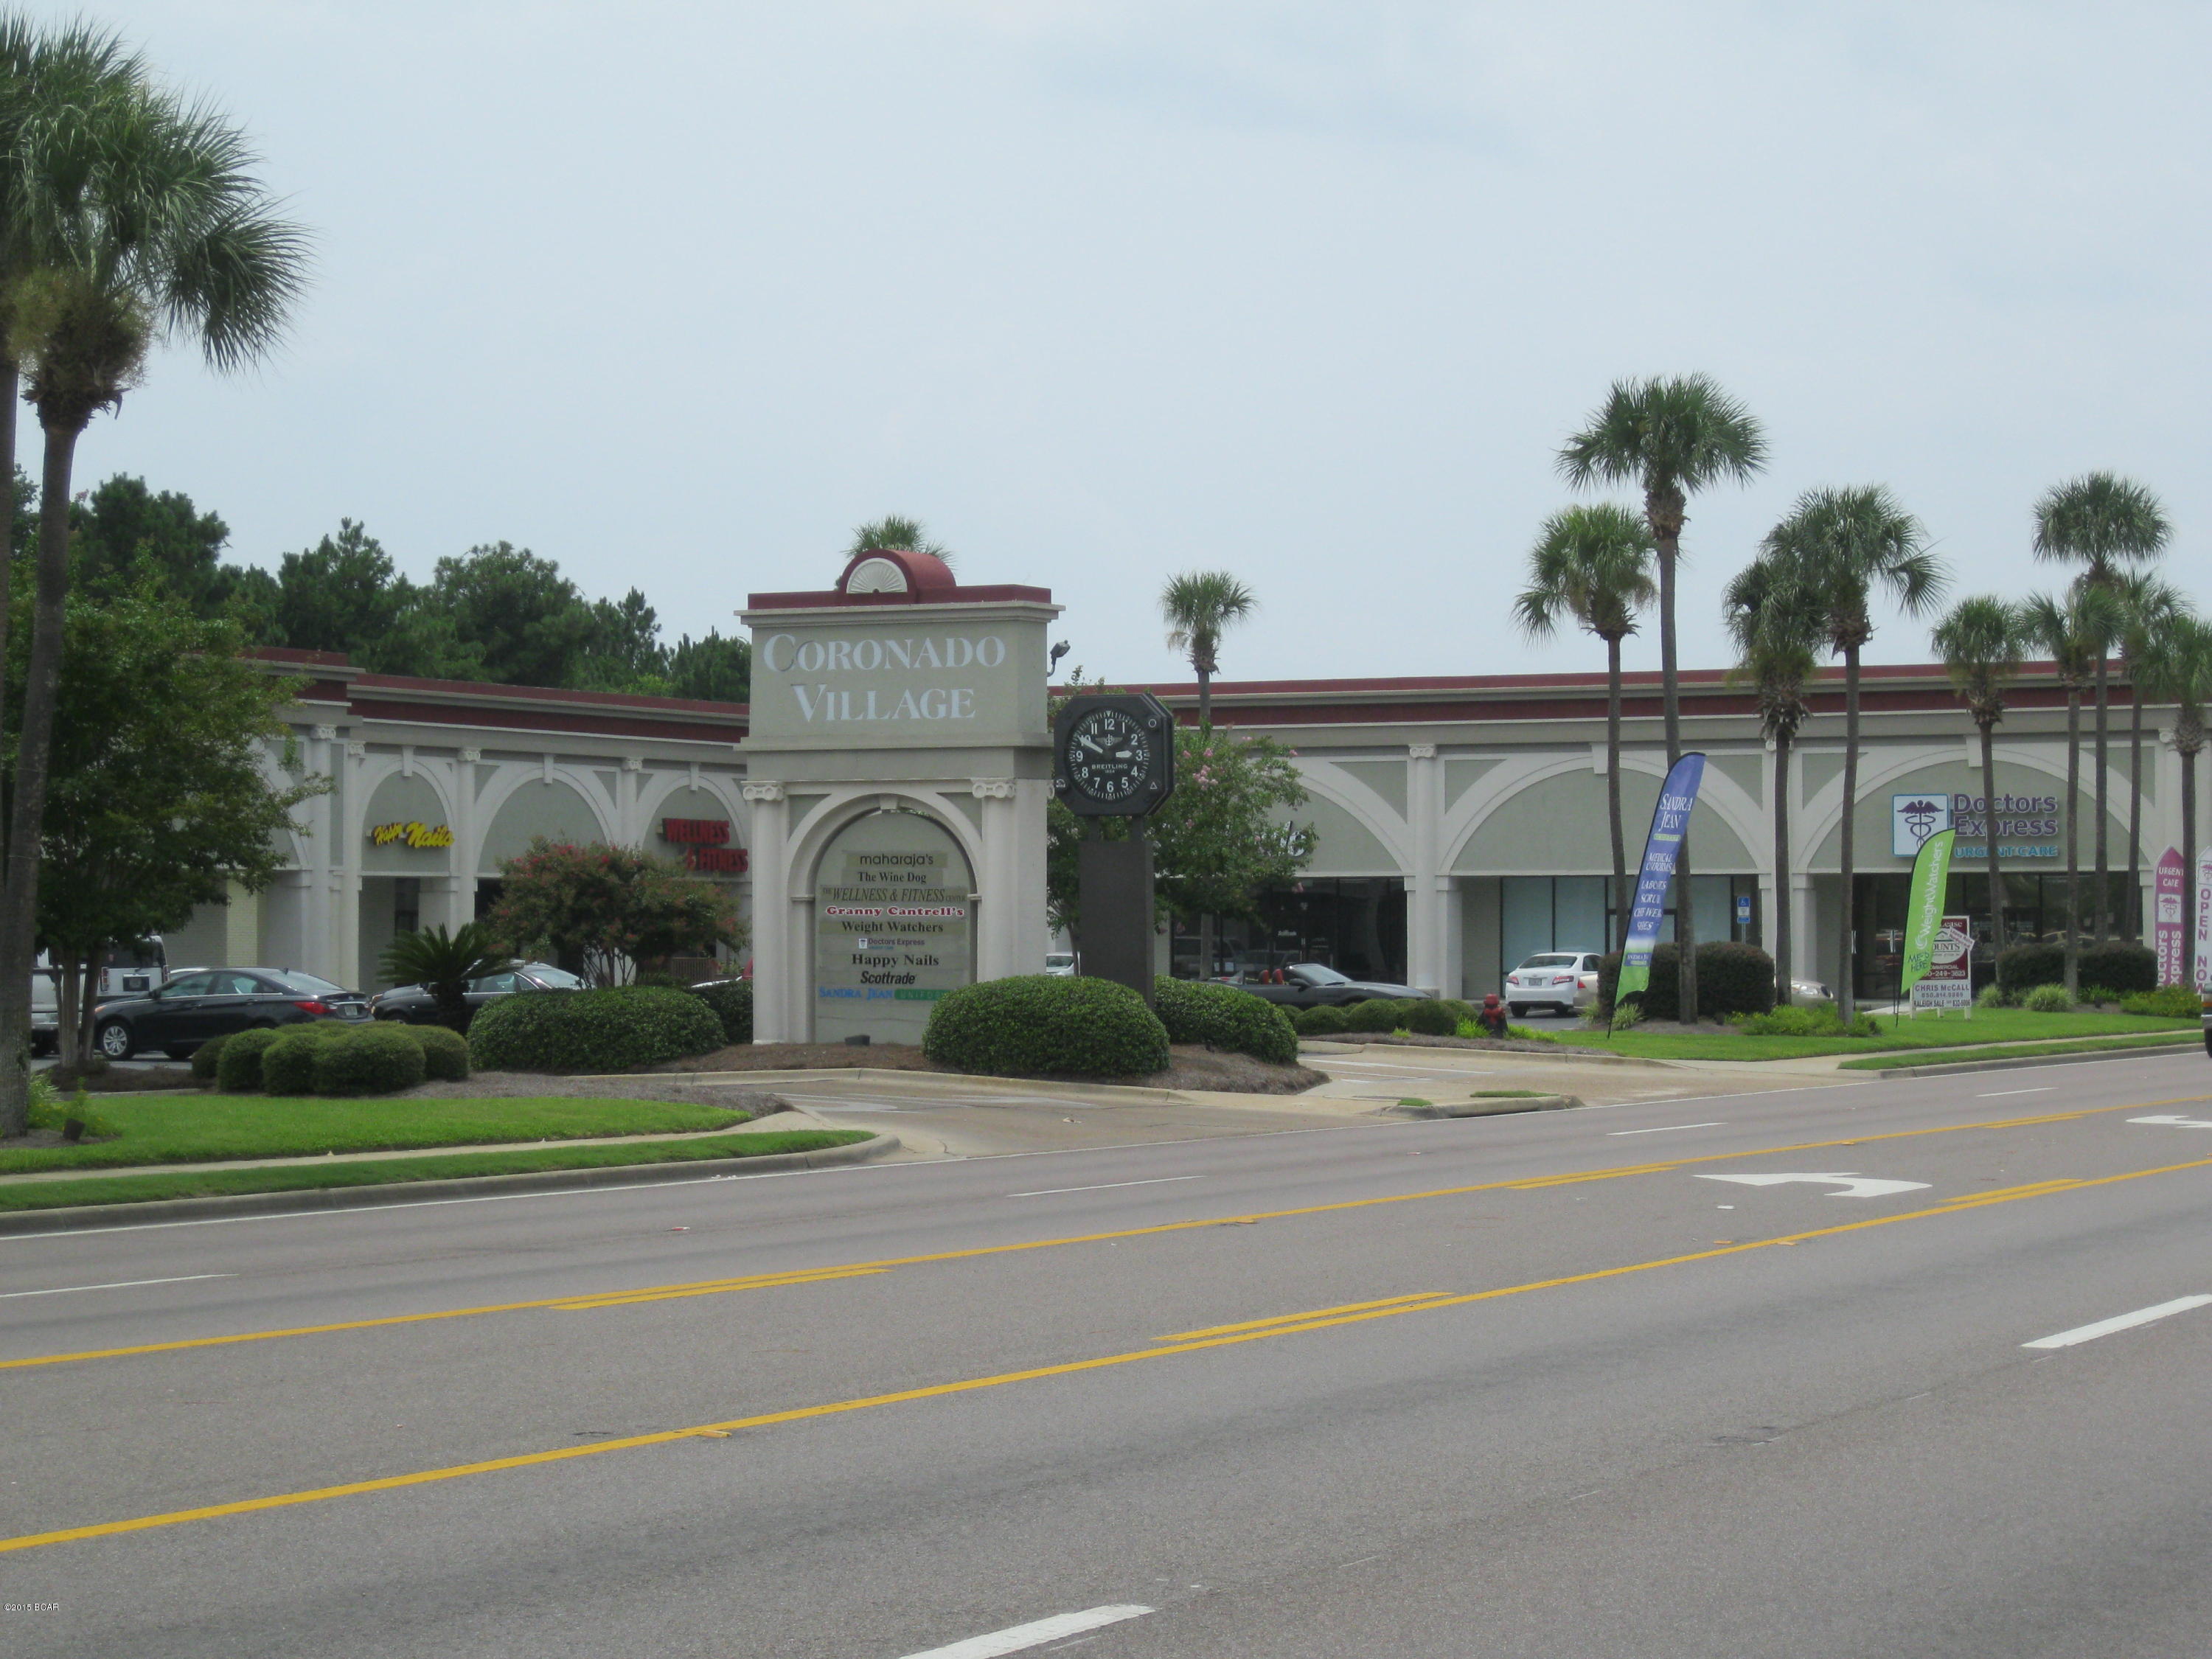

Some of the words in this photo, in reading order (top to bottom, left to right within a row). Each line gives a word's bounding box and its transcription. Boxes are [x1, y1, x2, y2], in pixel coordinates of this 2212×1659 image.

[763, 633, 1006, 672] CORONADO
[790, 684, 976, 722] VILLAGE
[1105, 718, 1115, 730] 12
[1131, 734, 1138, 745] 2
[1076, 751, 1084, 762] 9
[1135, 749, 1143, 761] 3
[1082, 767, 1089, 779] 8
[1130, 765, 1138, 777] 4
[1093, 777, 1101, 789] 7
[1107, 781, 1114, 793] 6
[1121, 777, 1129, 789] 5
[1660, 793, 1694, 811] SANDRA
[1953, 793, 2058, 813] Doctors
[1658, 811, 1682, 832] JEAN
[405, 821, 455, 849] Nails
[663, 818, 731, 844] WELLNESS
[1955, 846, 2014, 858] URGNT
[2017, 845, 2059, 858] CARE
[698, 847, 748, 873] FITNESS
[860, 853, 934, 867] maharaja's
[858, 872, 877, 882] The
[878, 872, 904, 882] Wine
[906, 872, 927, 883] Dog
[832, 887, 887, 902] WELLNESS
[889, 888, 898, 901] &
[901, 888, 945, 902] FITNESS
[1919, 841, 1944, 938] WeightWatchers
[826, 905, 883, 917] Granny
[887, 906, 964, 917] Cantrell's
[2198, 888, 2211, 942] OPEN
[841, 921, 883, 934] Weight
[886, 921, 944, 933] Watchers
[897, 938, 925, 947] Express
[852, 953, 898, 968] Happy
[904, 954, 940, 966] Nails
[2170, 931, 2183, 985] xpress
[860, 970, 916, 985] Scottrade
